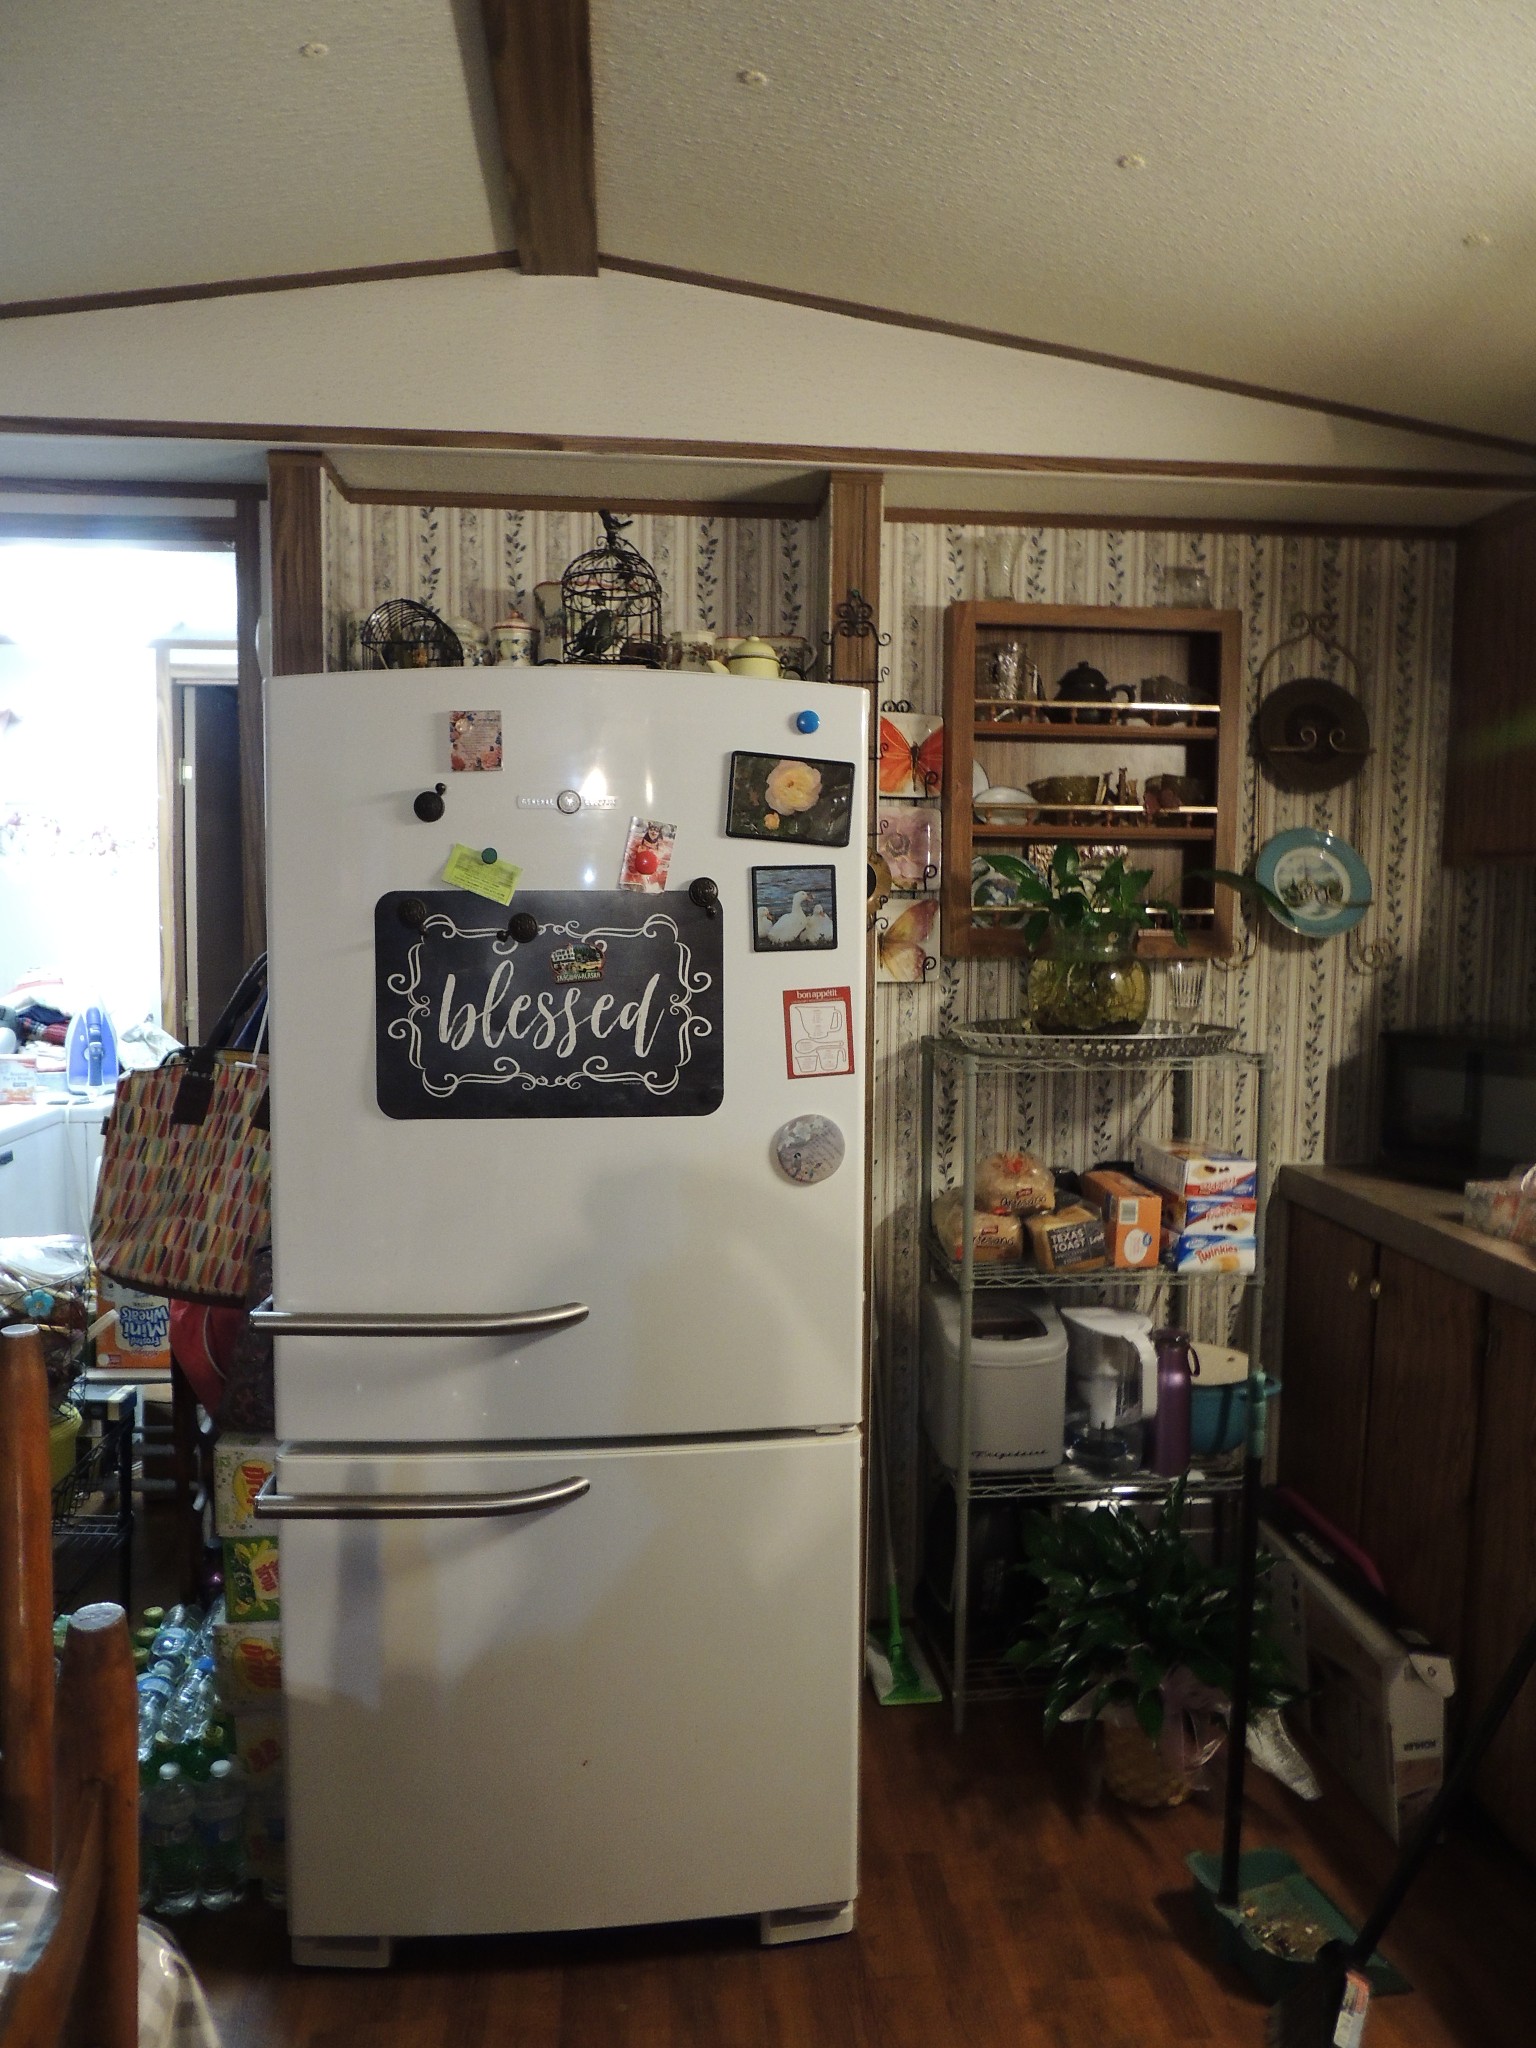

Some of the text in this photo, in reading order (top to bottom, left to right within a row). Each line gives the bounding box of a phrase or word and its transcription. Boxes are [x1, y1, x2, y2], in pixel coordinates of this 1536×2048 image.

[796, 990, 811, 999] bon
[439, 960, 665, 1058] blessed
[1051, 1228, 1084, 1245] TEXAS
[1053, 1237, 1086, 1254] TOAST
[1195, 1245, 1238, 1264] Twinkies
[121, 1305, 168, 1323] Wheats
[123, 1320, 166, 1338] Mini
